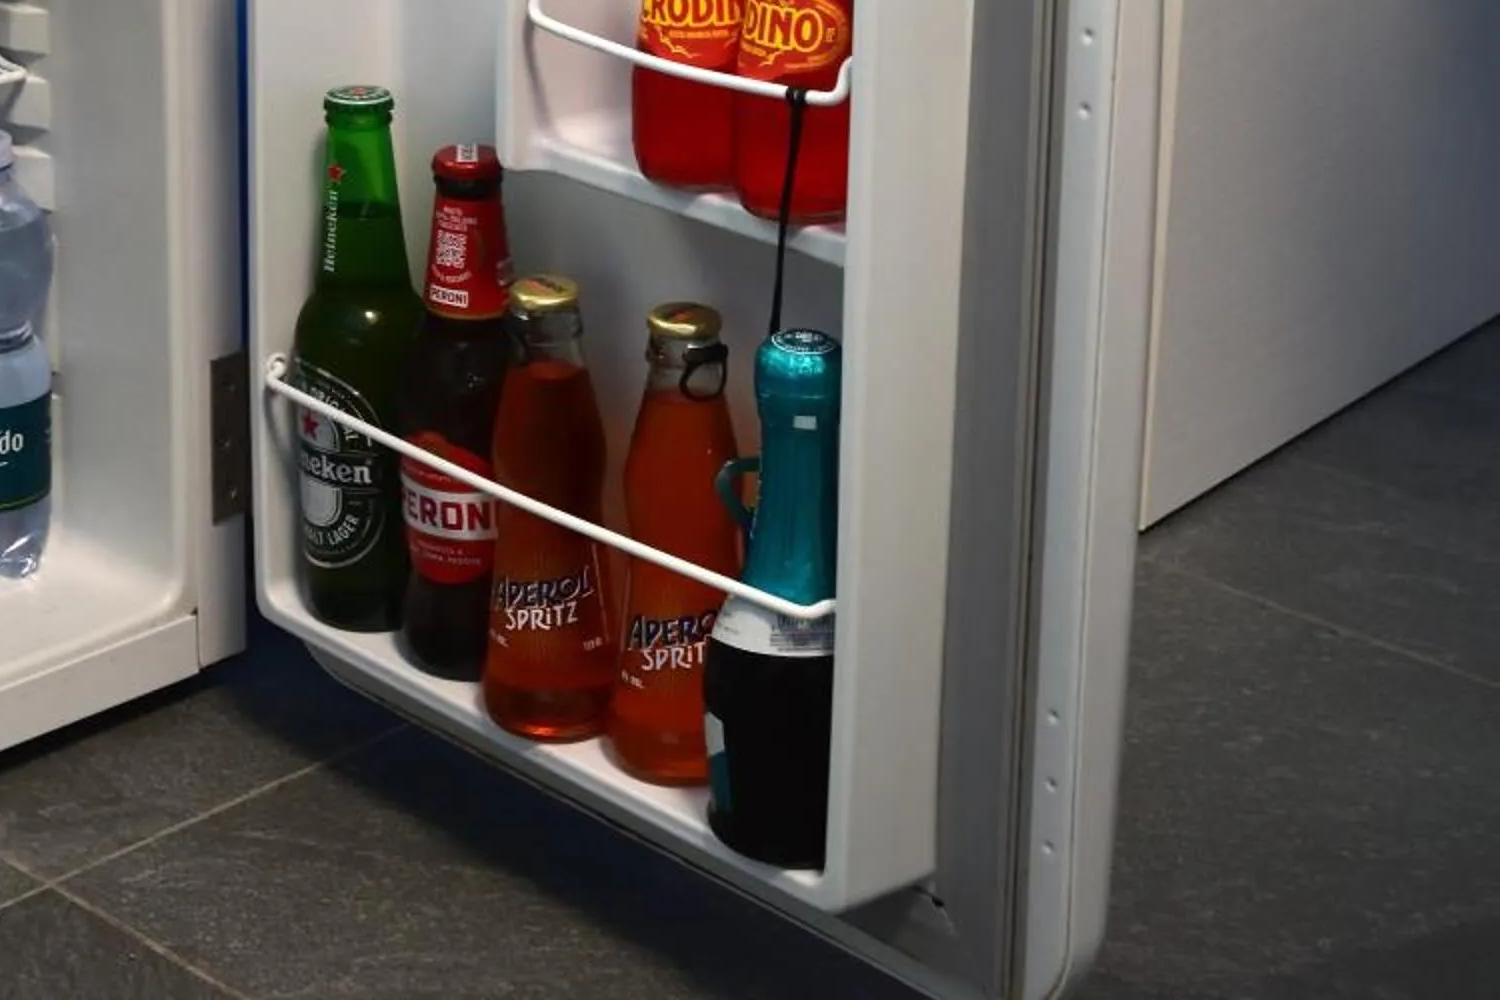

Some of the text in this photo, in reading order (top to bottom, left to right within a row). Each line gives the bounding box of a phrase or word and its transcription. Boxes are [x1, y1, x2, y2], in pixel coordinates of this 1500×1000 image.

[323, 190, 339, 273] Heineken
[430, 287, 468, 306] PERONI
[401, 490, 498, 531] ERON
[627, 608, 719, 652] APERO
[641, 640, 707, 672] SPRiT
